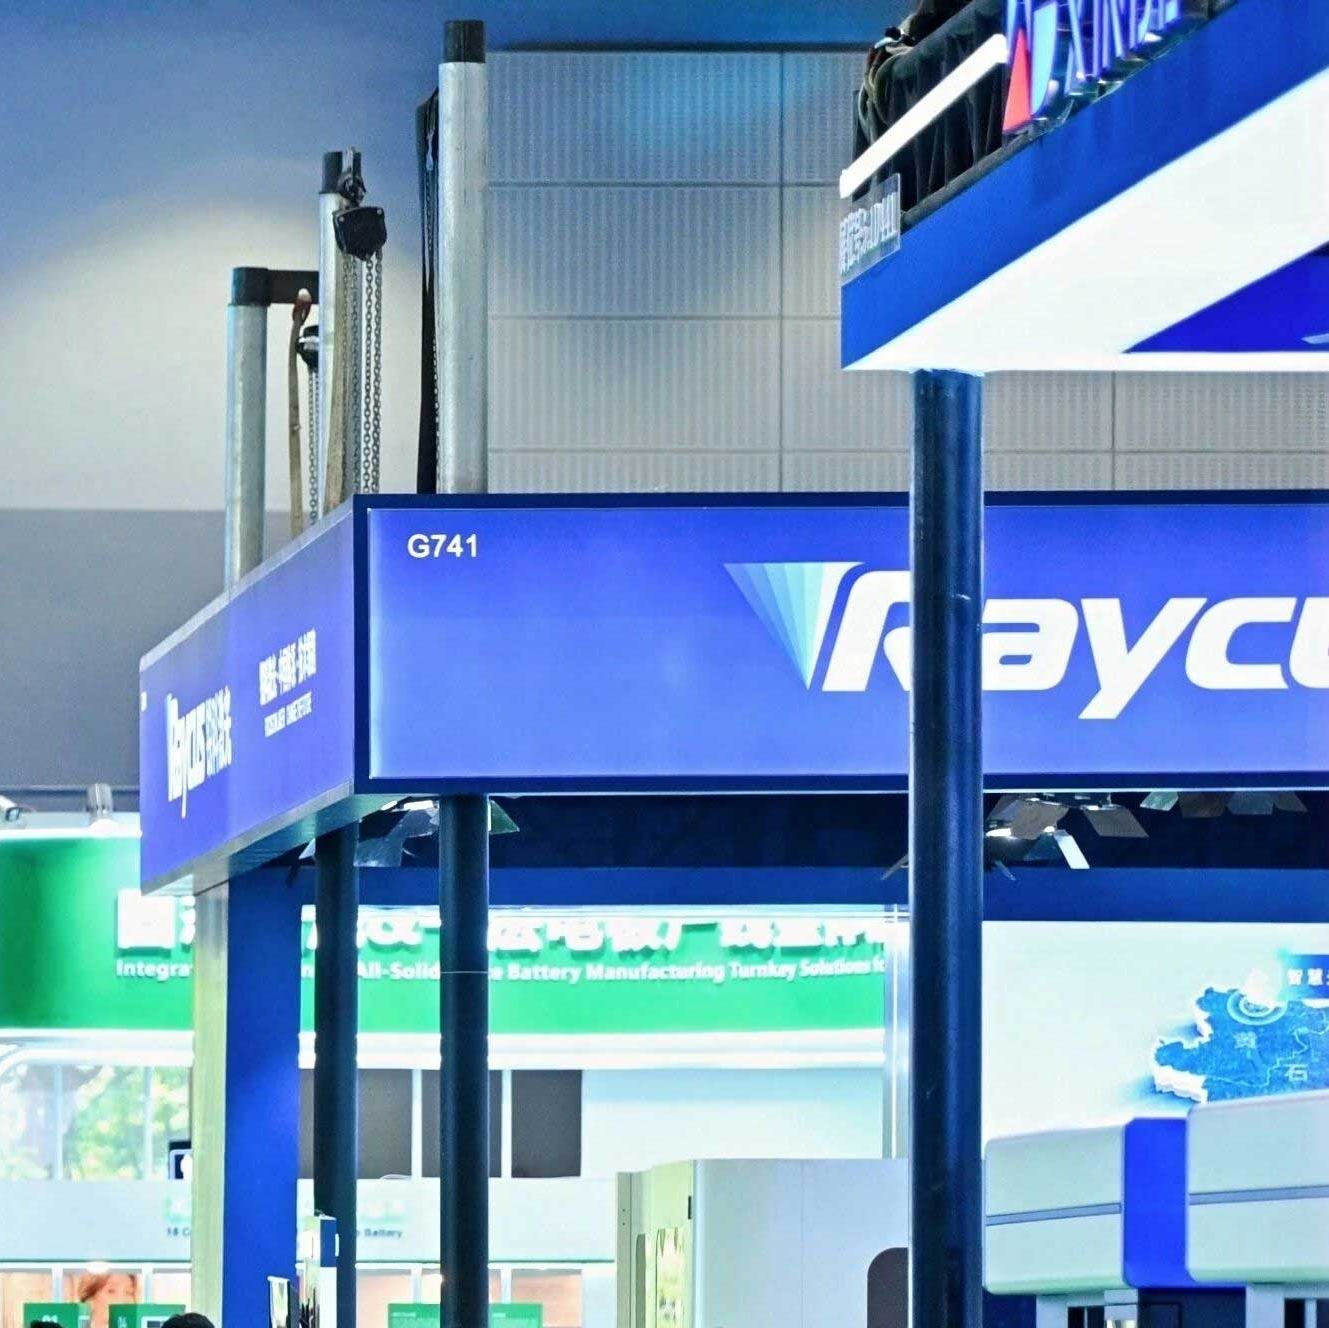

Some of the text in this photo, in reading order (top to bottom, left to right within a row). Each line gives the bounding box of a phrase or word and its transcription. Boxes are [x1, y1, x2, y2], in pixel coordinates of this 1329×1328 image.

[407, 533, 477, 558] G741
[116, 959, 192, 981] Integra
[508, 963, 582, 984] Battery
[586, 962, 726, 984] Manufacturing
[730, 961, 798, 982] Turnkey
[799, 956, 871, 978] Solutions
